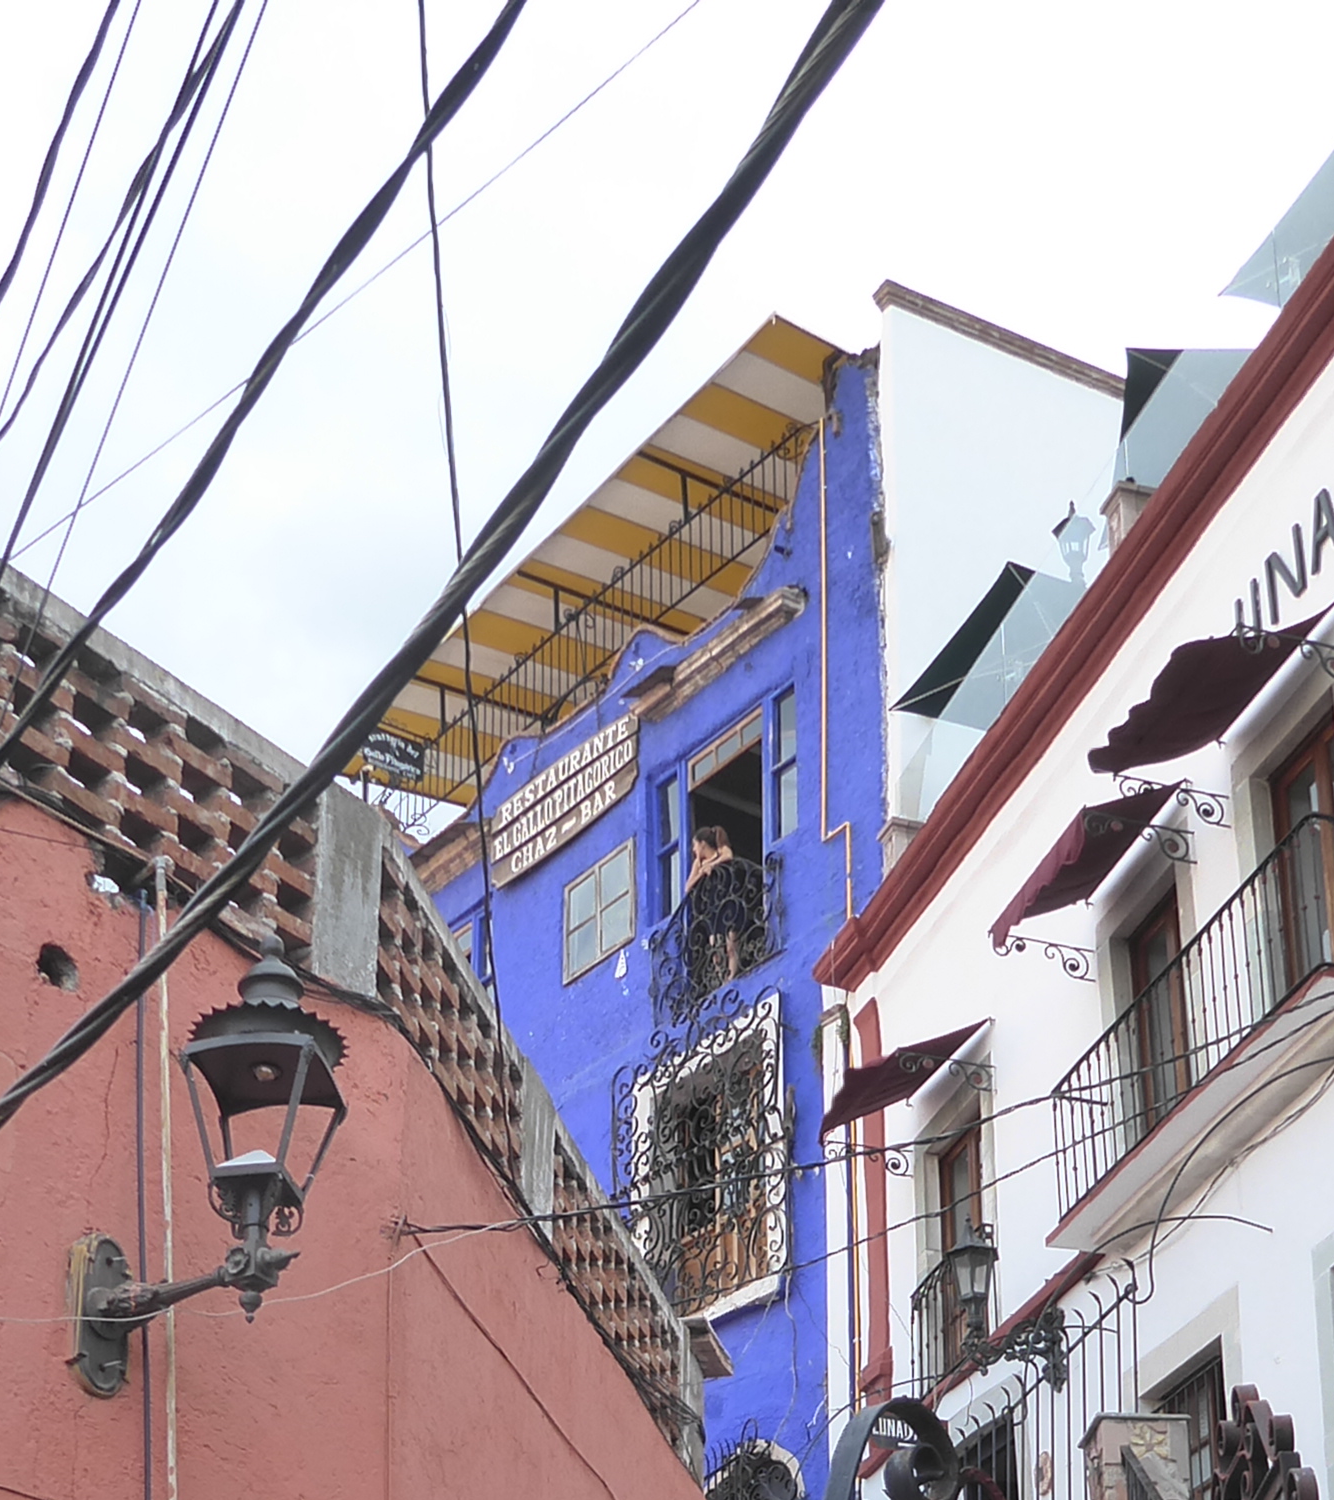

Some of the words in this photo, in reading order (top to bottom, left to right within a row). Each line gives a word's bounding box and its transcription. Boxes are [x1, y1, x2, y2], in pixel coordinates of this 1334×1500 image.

[498, 716, 629, 829] RESTAURANTE
[580, 781, 616, 824] BAR
[494, 832, 511, 860] EL
